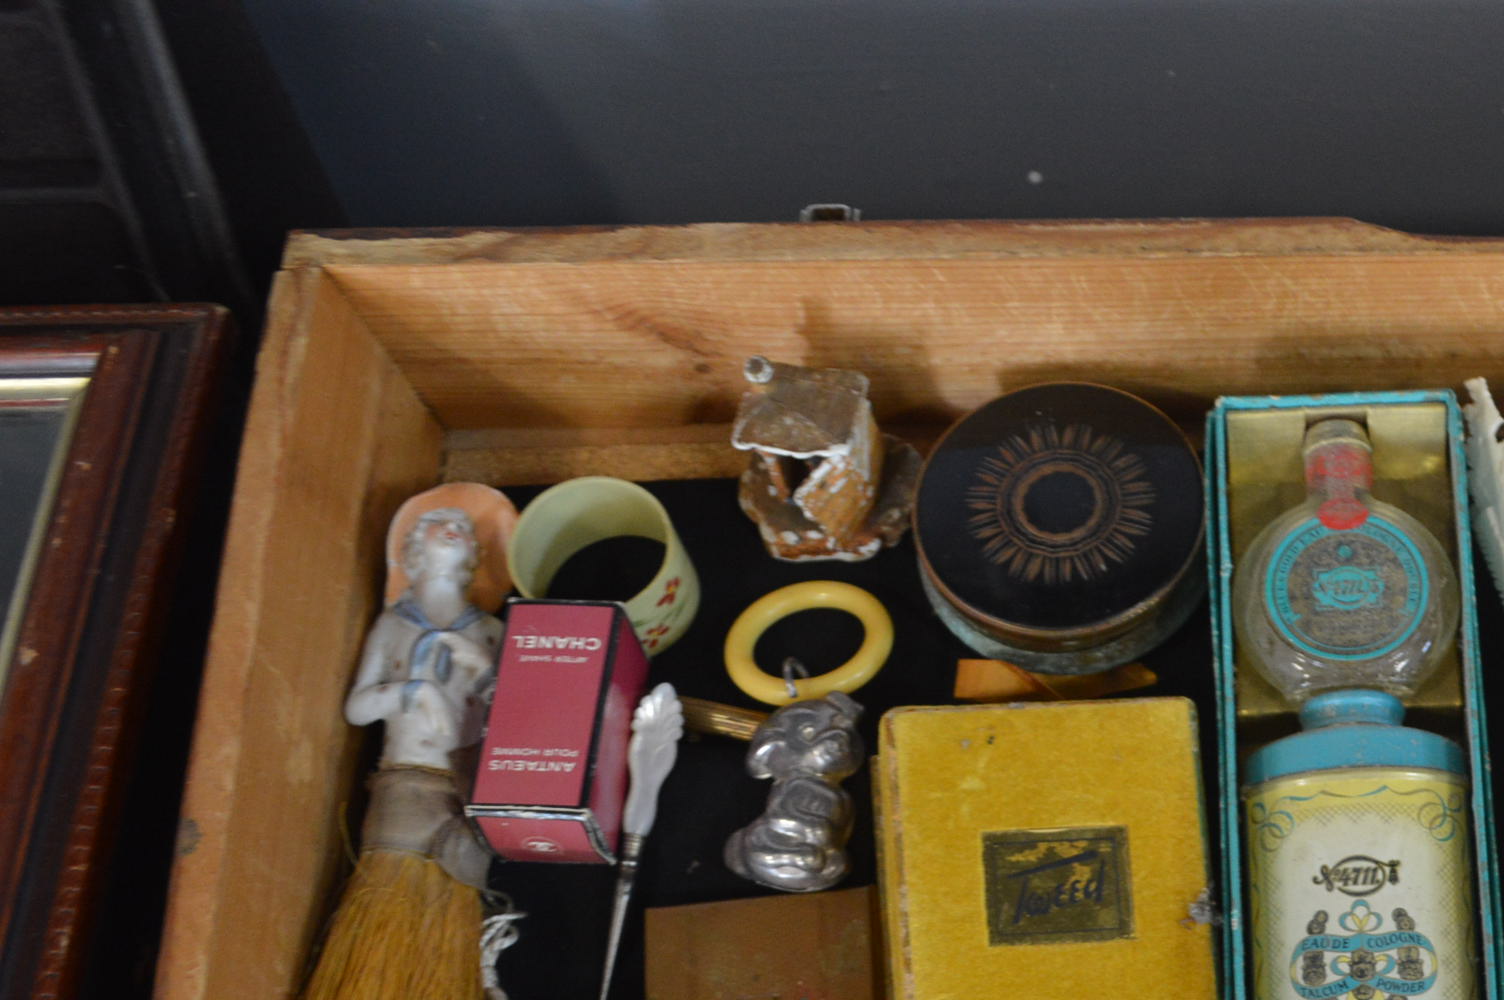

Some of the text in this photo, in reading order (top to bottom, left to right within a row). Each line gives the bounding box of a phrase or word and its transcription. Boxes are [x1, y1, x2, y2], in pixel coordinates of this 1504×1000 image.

[512, 635, 602, 650] CHANEL
[491, 747, 580, 758] POUR HOMME
[488, 759, 577, 773] ANTAEUS
[1302, 934, 1426, 951] EAU DE COLOGNE
[1299, 979, 1425, 998] TALCUM POWDER
